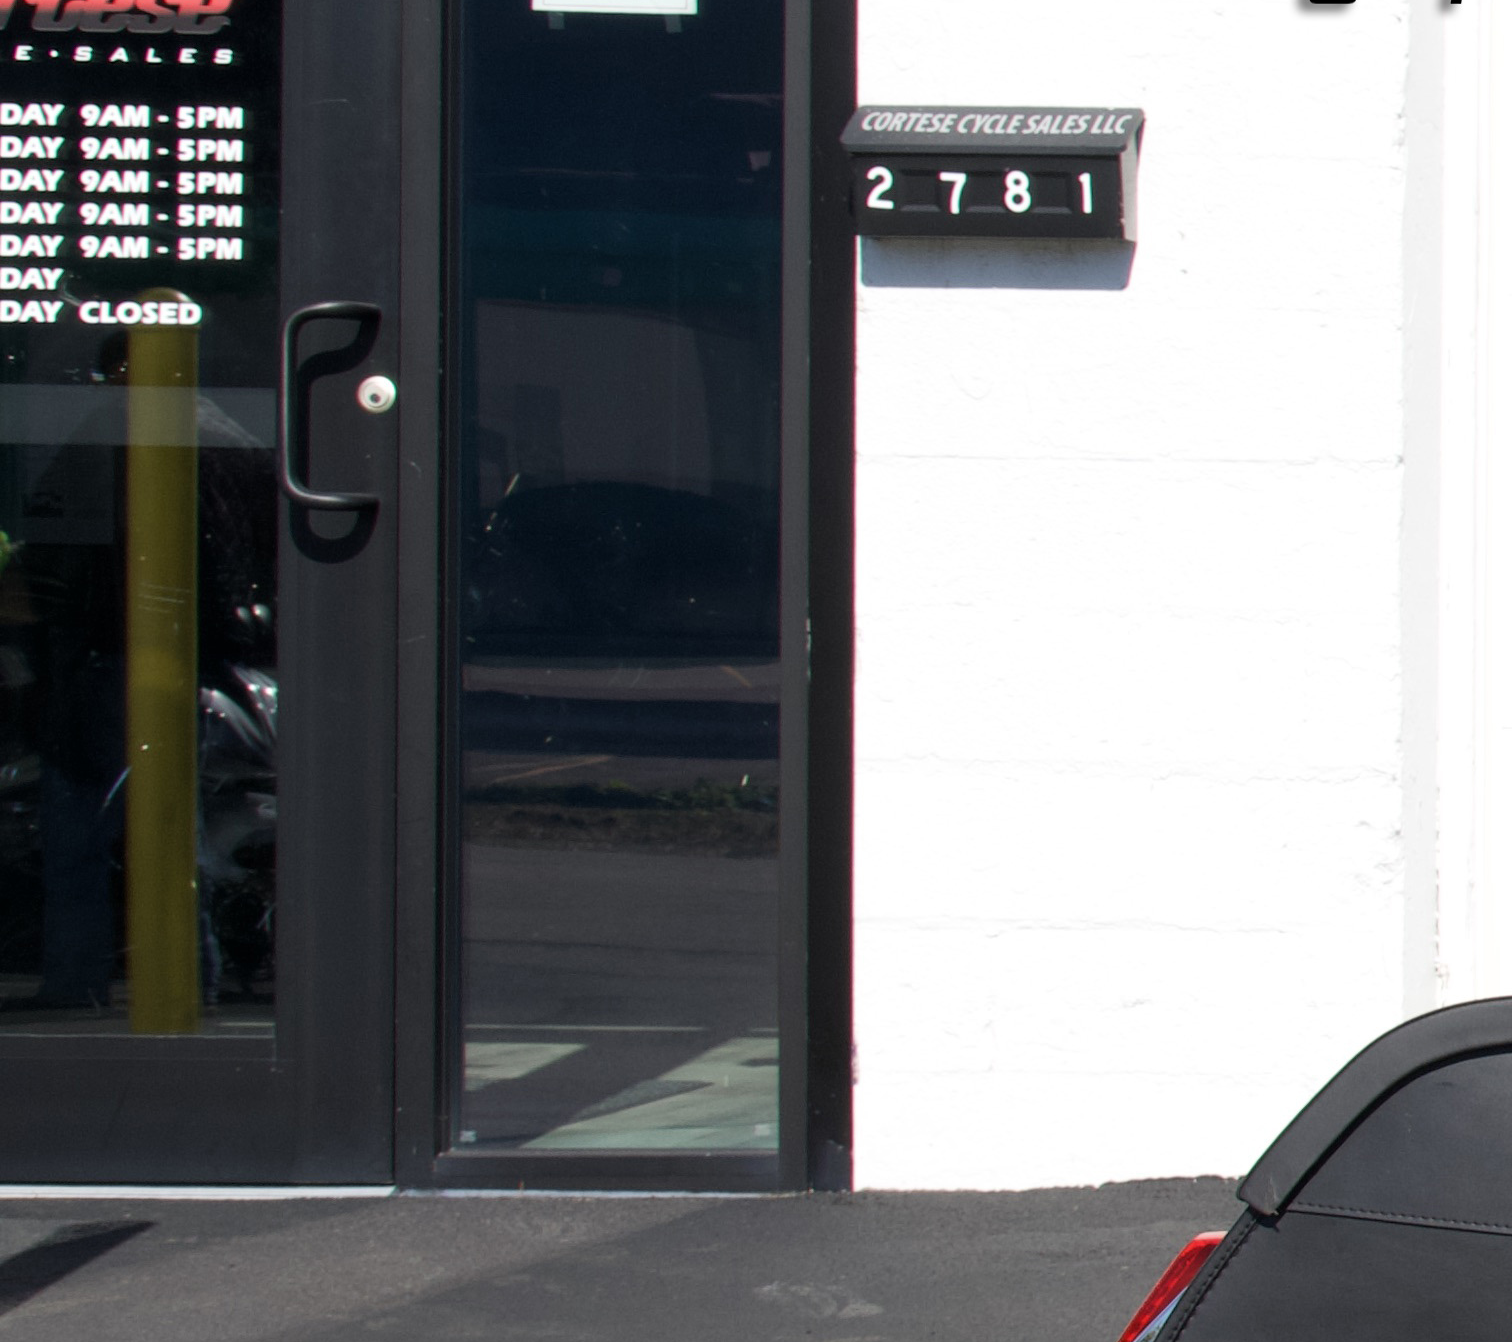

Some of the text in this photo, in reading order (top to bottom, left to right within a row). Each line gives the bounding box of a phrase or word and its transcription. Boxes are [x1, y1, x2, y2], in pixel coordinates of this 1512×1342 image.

[74, 46, 234, 65] SALES
[80, 104, 150, 128] 9AM
[176, 106, 244, 129] 5PM
[861, 111, 1133, 135] CORTESE CYCLE SALES LLC
[80, 137, 150, 161] 9AM
[176, 139, 244, 162] 5PM
[80, 170, 150, 194] 9AM
[176, 172, 244, 195] 5PM
[866, 166, 1092, 214] 2781
[80, 203, 150, 227] 9AM
[176, 205, 244, 228] 5PM
[80, 236, 150, 260] 9AM
[176, 238, 244, 261] 5PM
[79, 301, 202, 325] CLOSED
